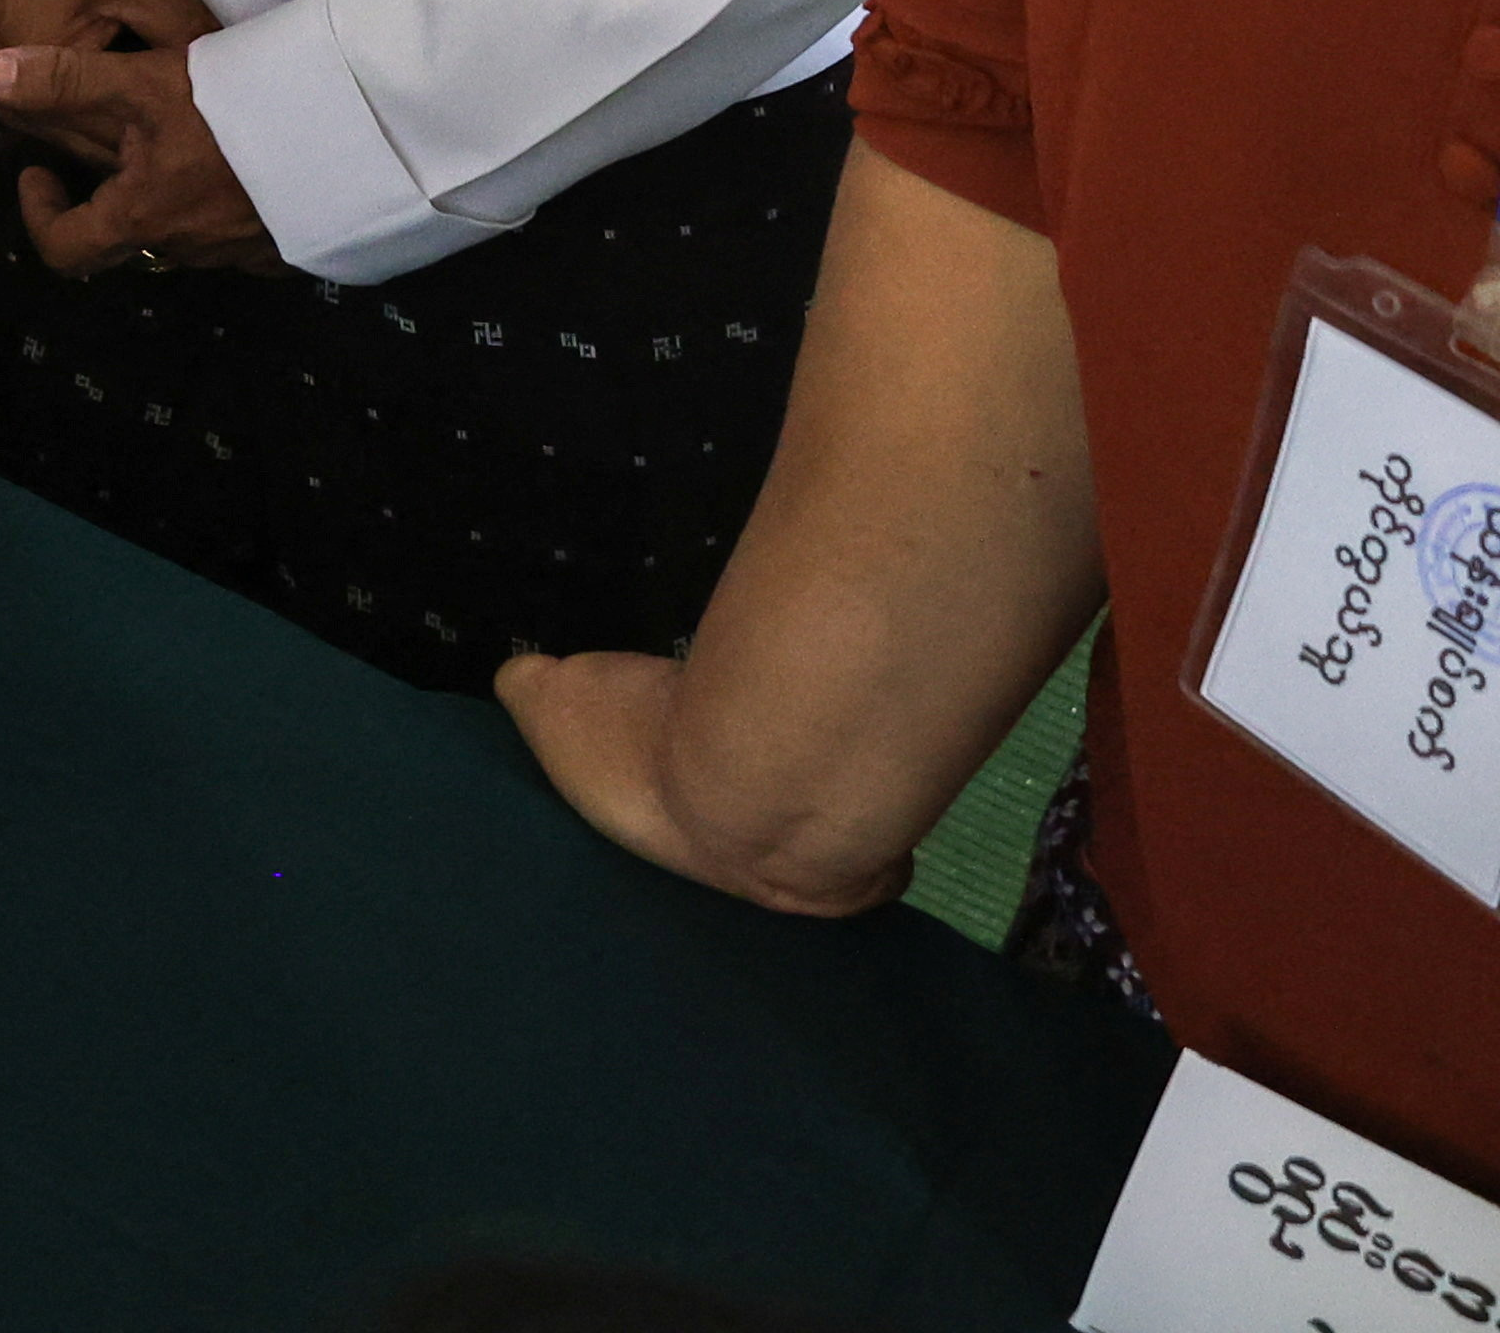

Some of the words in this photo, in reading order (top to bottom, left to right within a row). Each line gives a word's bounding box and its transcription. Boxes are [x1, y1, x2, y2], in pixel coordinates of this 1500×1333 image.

[1298, 452, 1425, 686] ကိုင်တွယ်သူ
